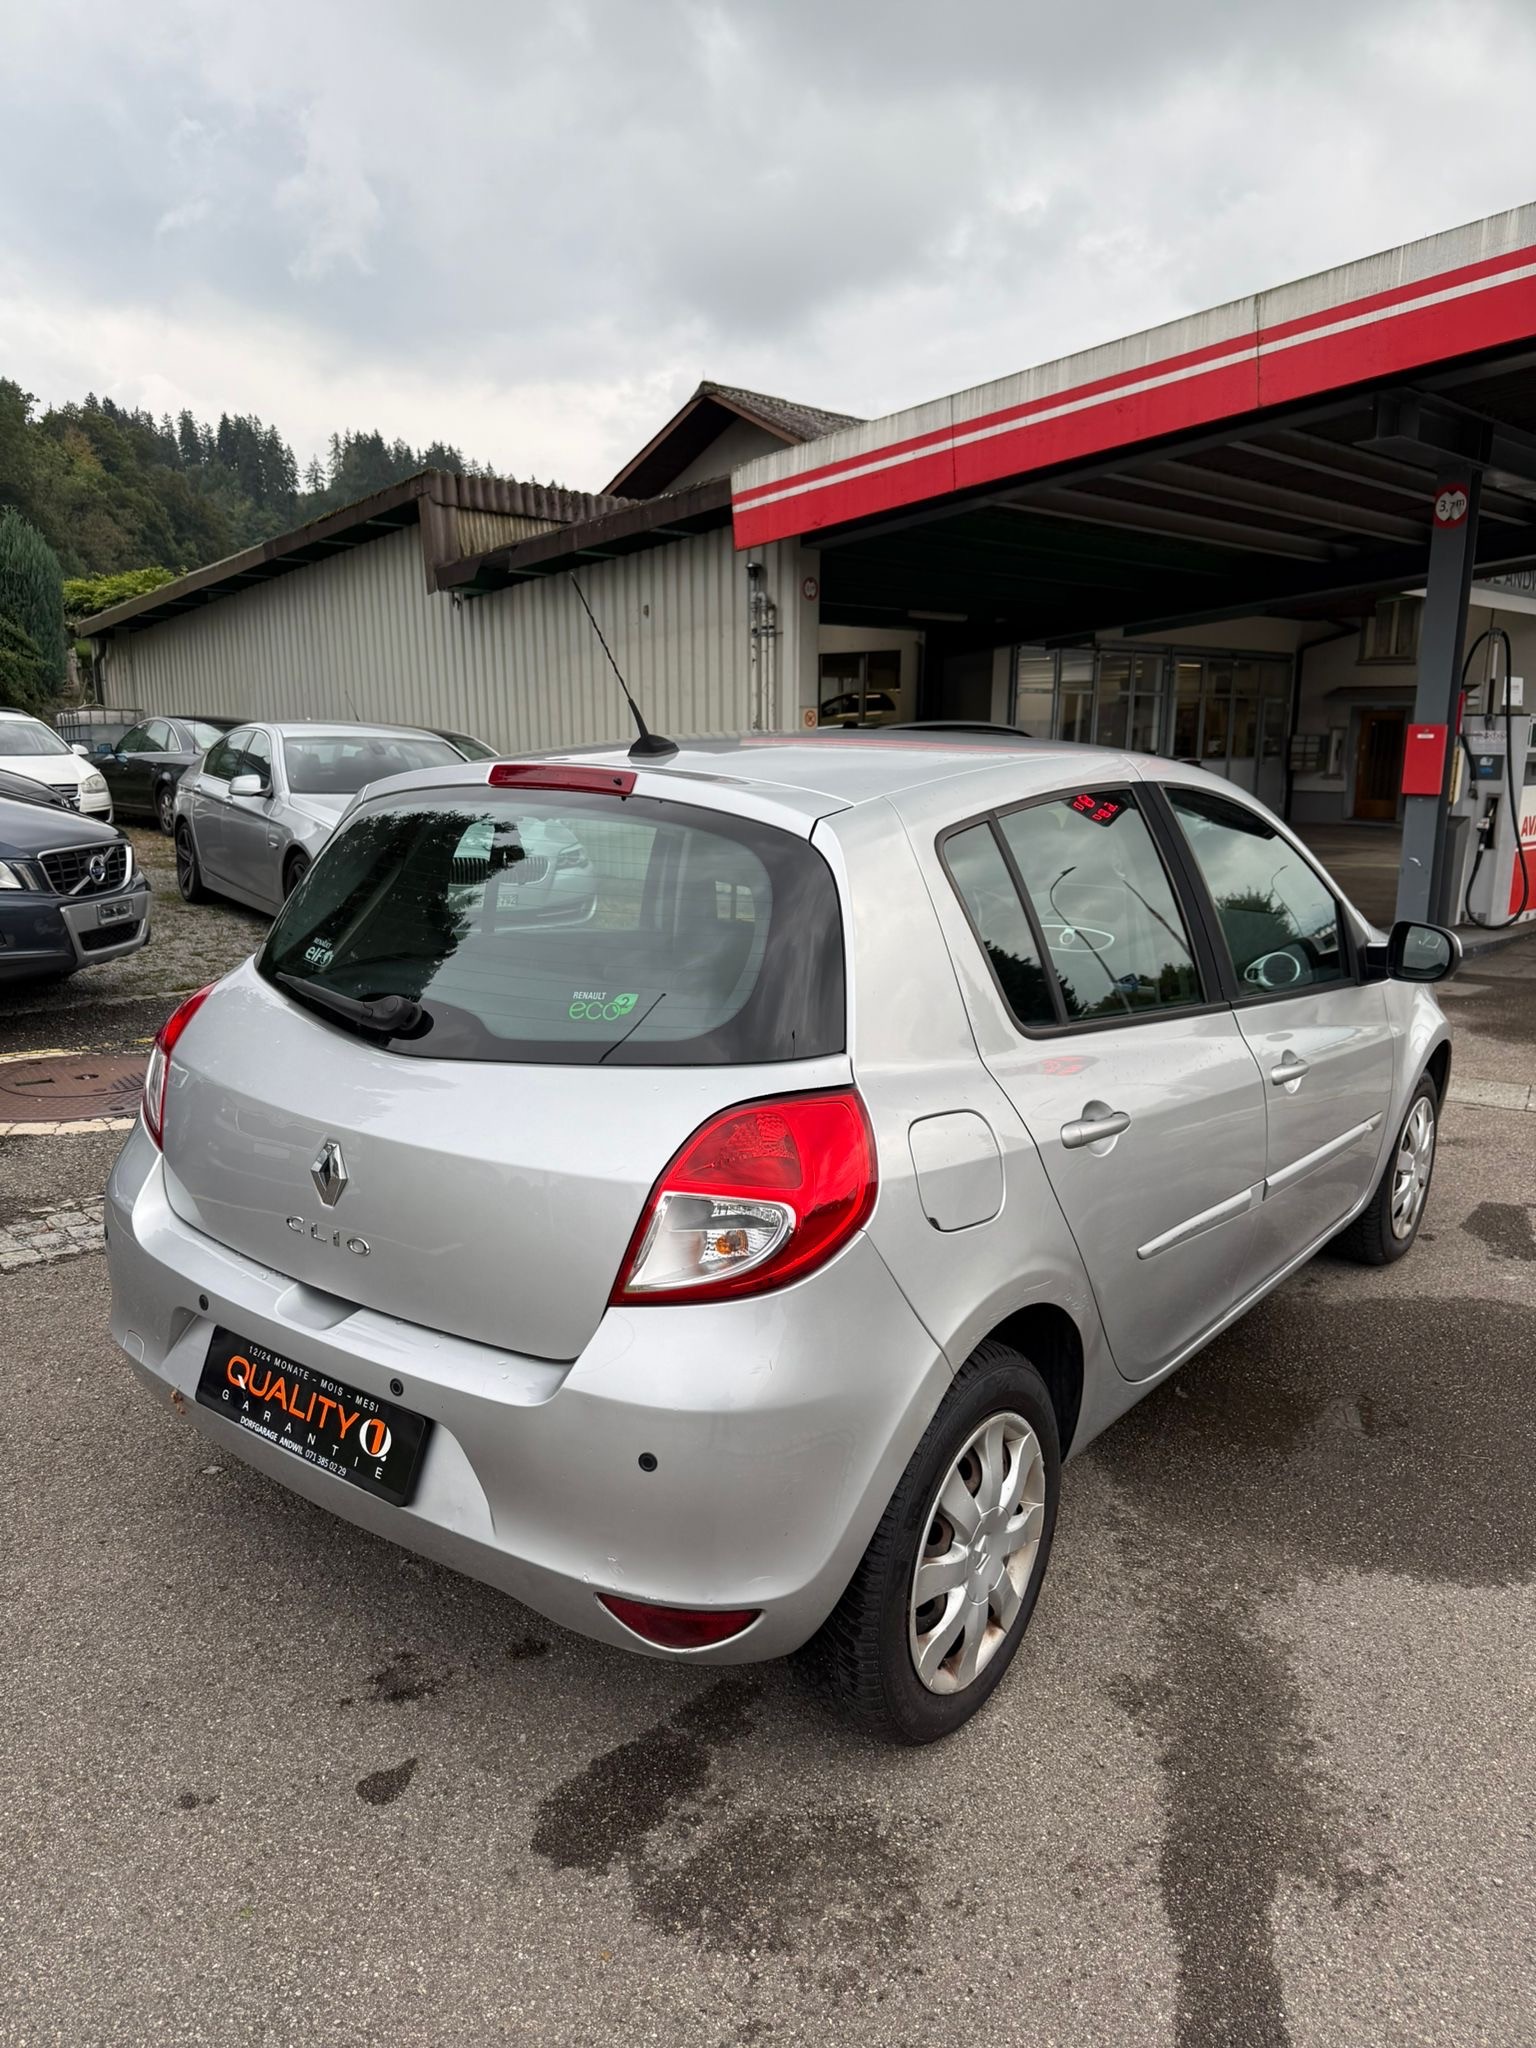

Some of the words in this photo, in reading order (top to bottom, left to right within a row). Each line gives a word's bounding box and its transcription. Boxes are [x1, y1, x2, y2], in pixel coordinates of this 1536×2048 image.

[572, 991, 607, 1000] RENAULT
[286, 1215, 371, 1257] CLIO
[226, 1354, 361, 1440] QUALITY
[249, 1345, 272, 1362] 12/24
[274, 1357, 310, 1380] MONATE
[320, 1379, 344, 1397] MOIS
[355, 1395, 380, 1413] MESI
[239, 1415, 278, 1442] DORFGARAGE
[278, 1436, 303, 1455] ANDWIL
[305, 1449, 317, 1461] 071
[316, 1455, 329, 1468] 385
[328, 1461, 338, 1472] 02
[337, 1465, 347, 1477] 29
